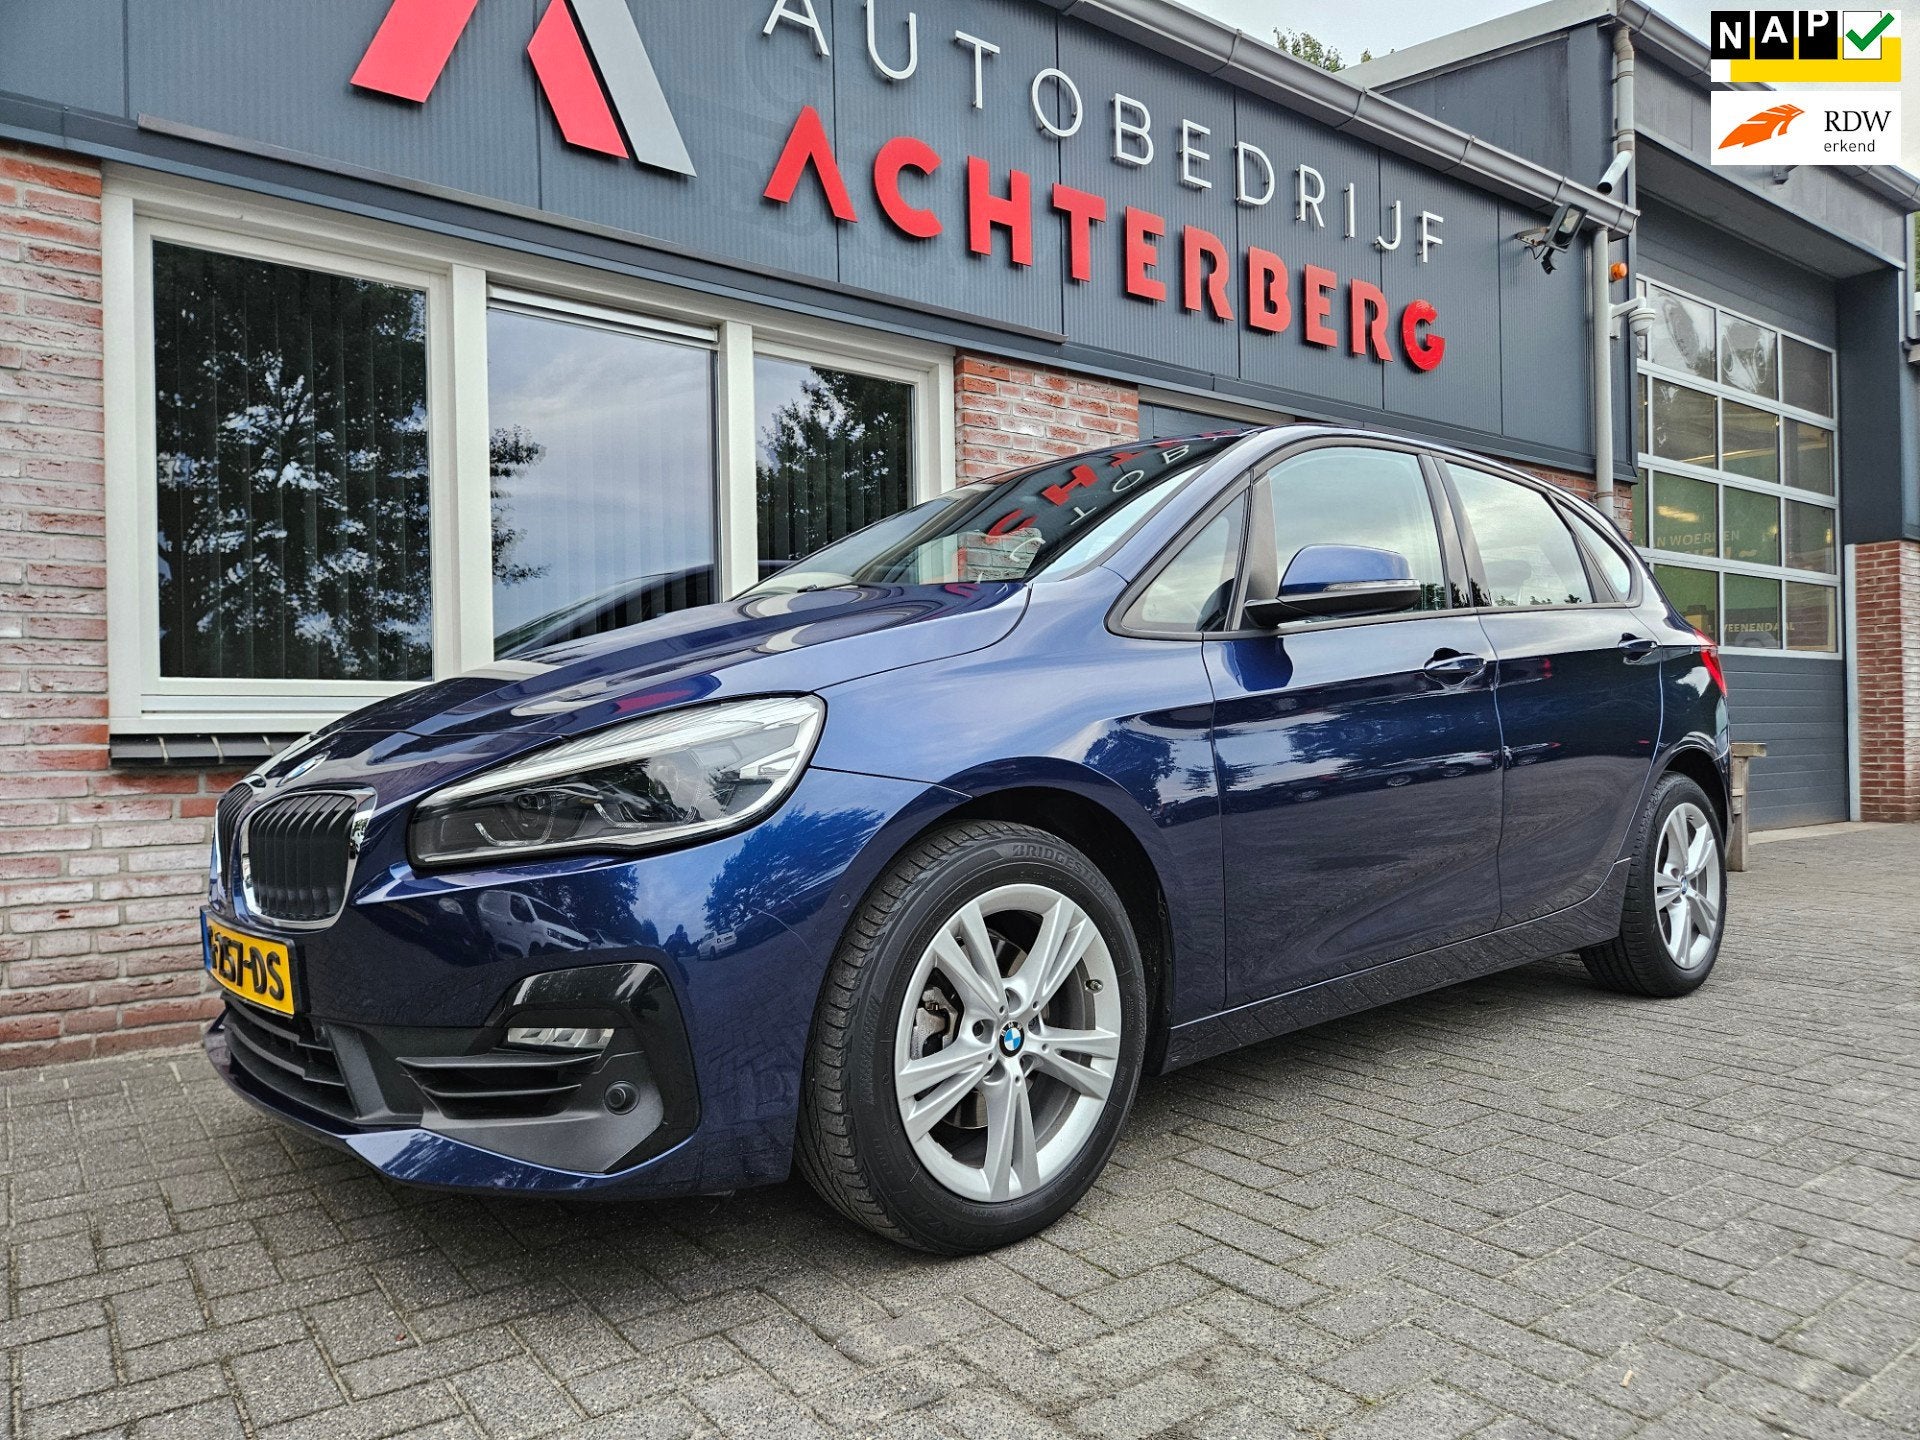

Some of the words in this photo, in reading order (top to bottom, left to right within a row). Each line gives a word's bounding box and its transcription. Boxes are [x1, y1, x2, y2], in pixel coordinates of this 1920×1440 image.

[763, 0, 1444, 264] AUTOBEDRIJF
[764, 105, 1446, 371] ACHTERBERG
[1670, 530, 1740, 547] WOEREN
